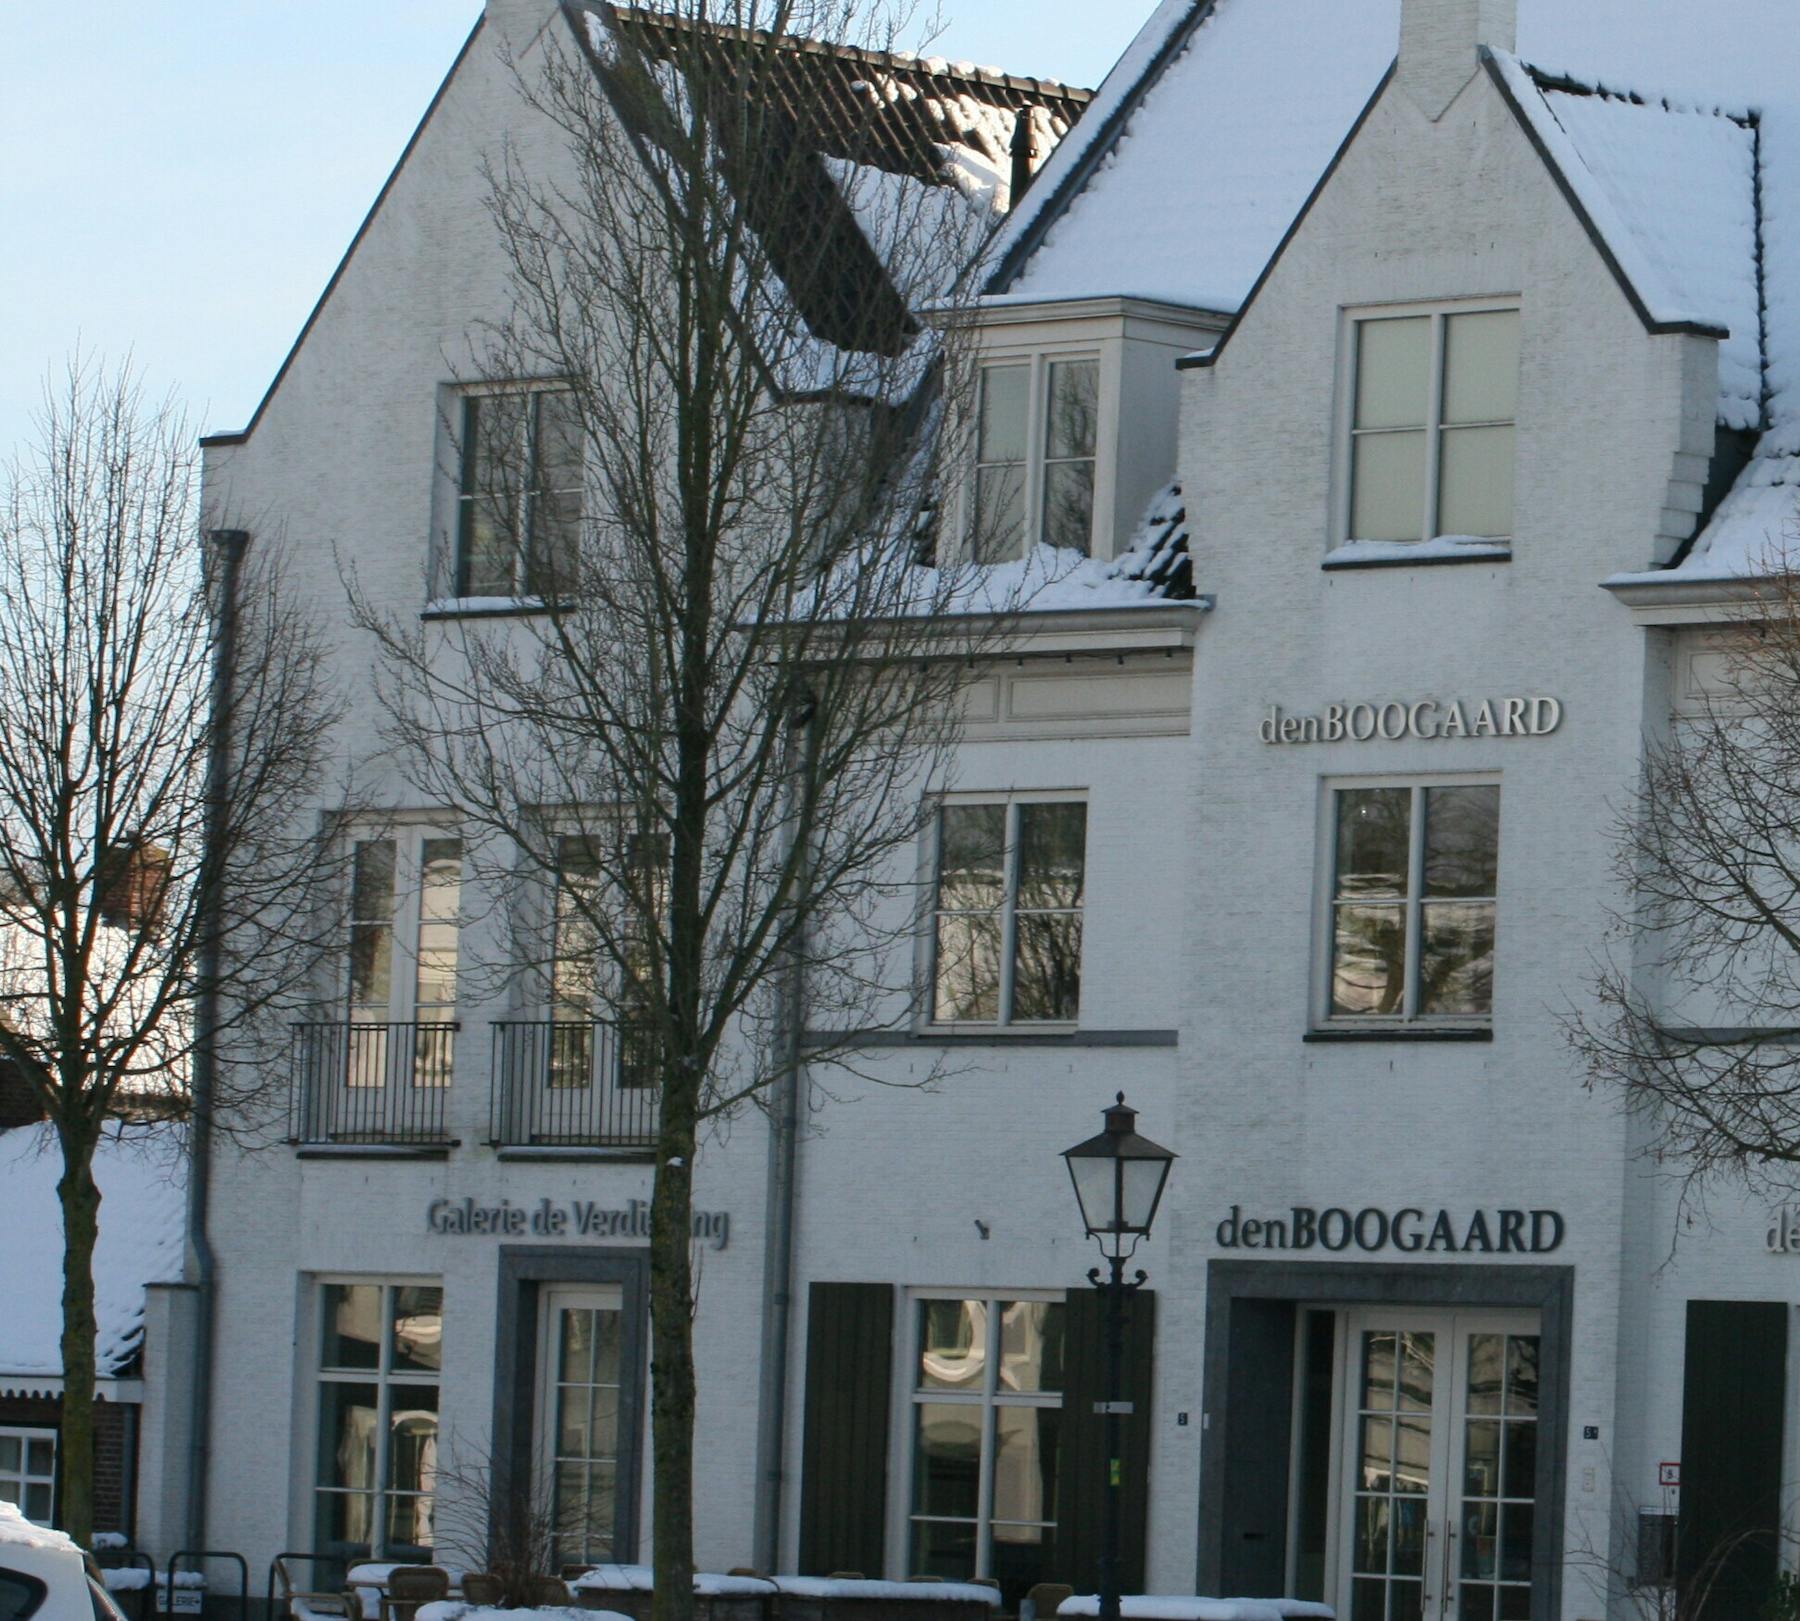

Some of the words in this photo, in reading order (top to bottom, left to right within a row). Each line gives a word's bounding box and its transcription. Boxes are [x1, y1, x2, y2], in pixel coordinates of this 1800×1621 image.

[1259, 697, 1562, 743] denBOOGAARD
[428, 1198, 525, 1235] Galerie
[530, 1198, 567, 1236] de
[573, 1199, 729, 1250] Verding
[1216, 1205, 1565, 1252] denBOOGAARD
